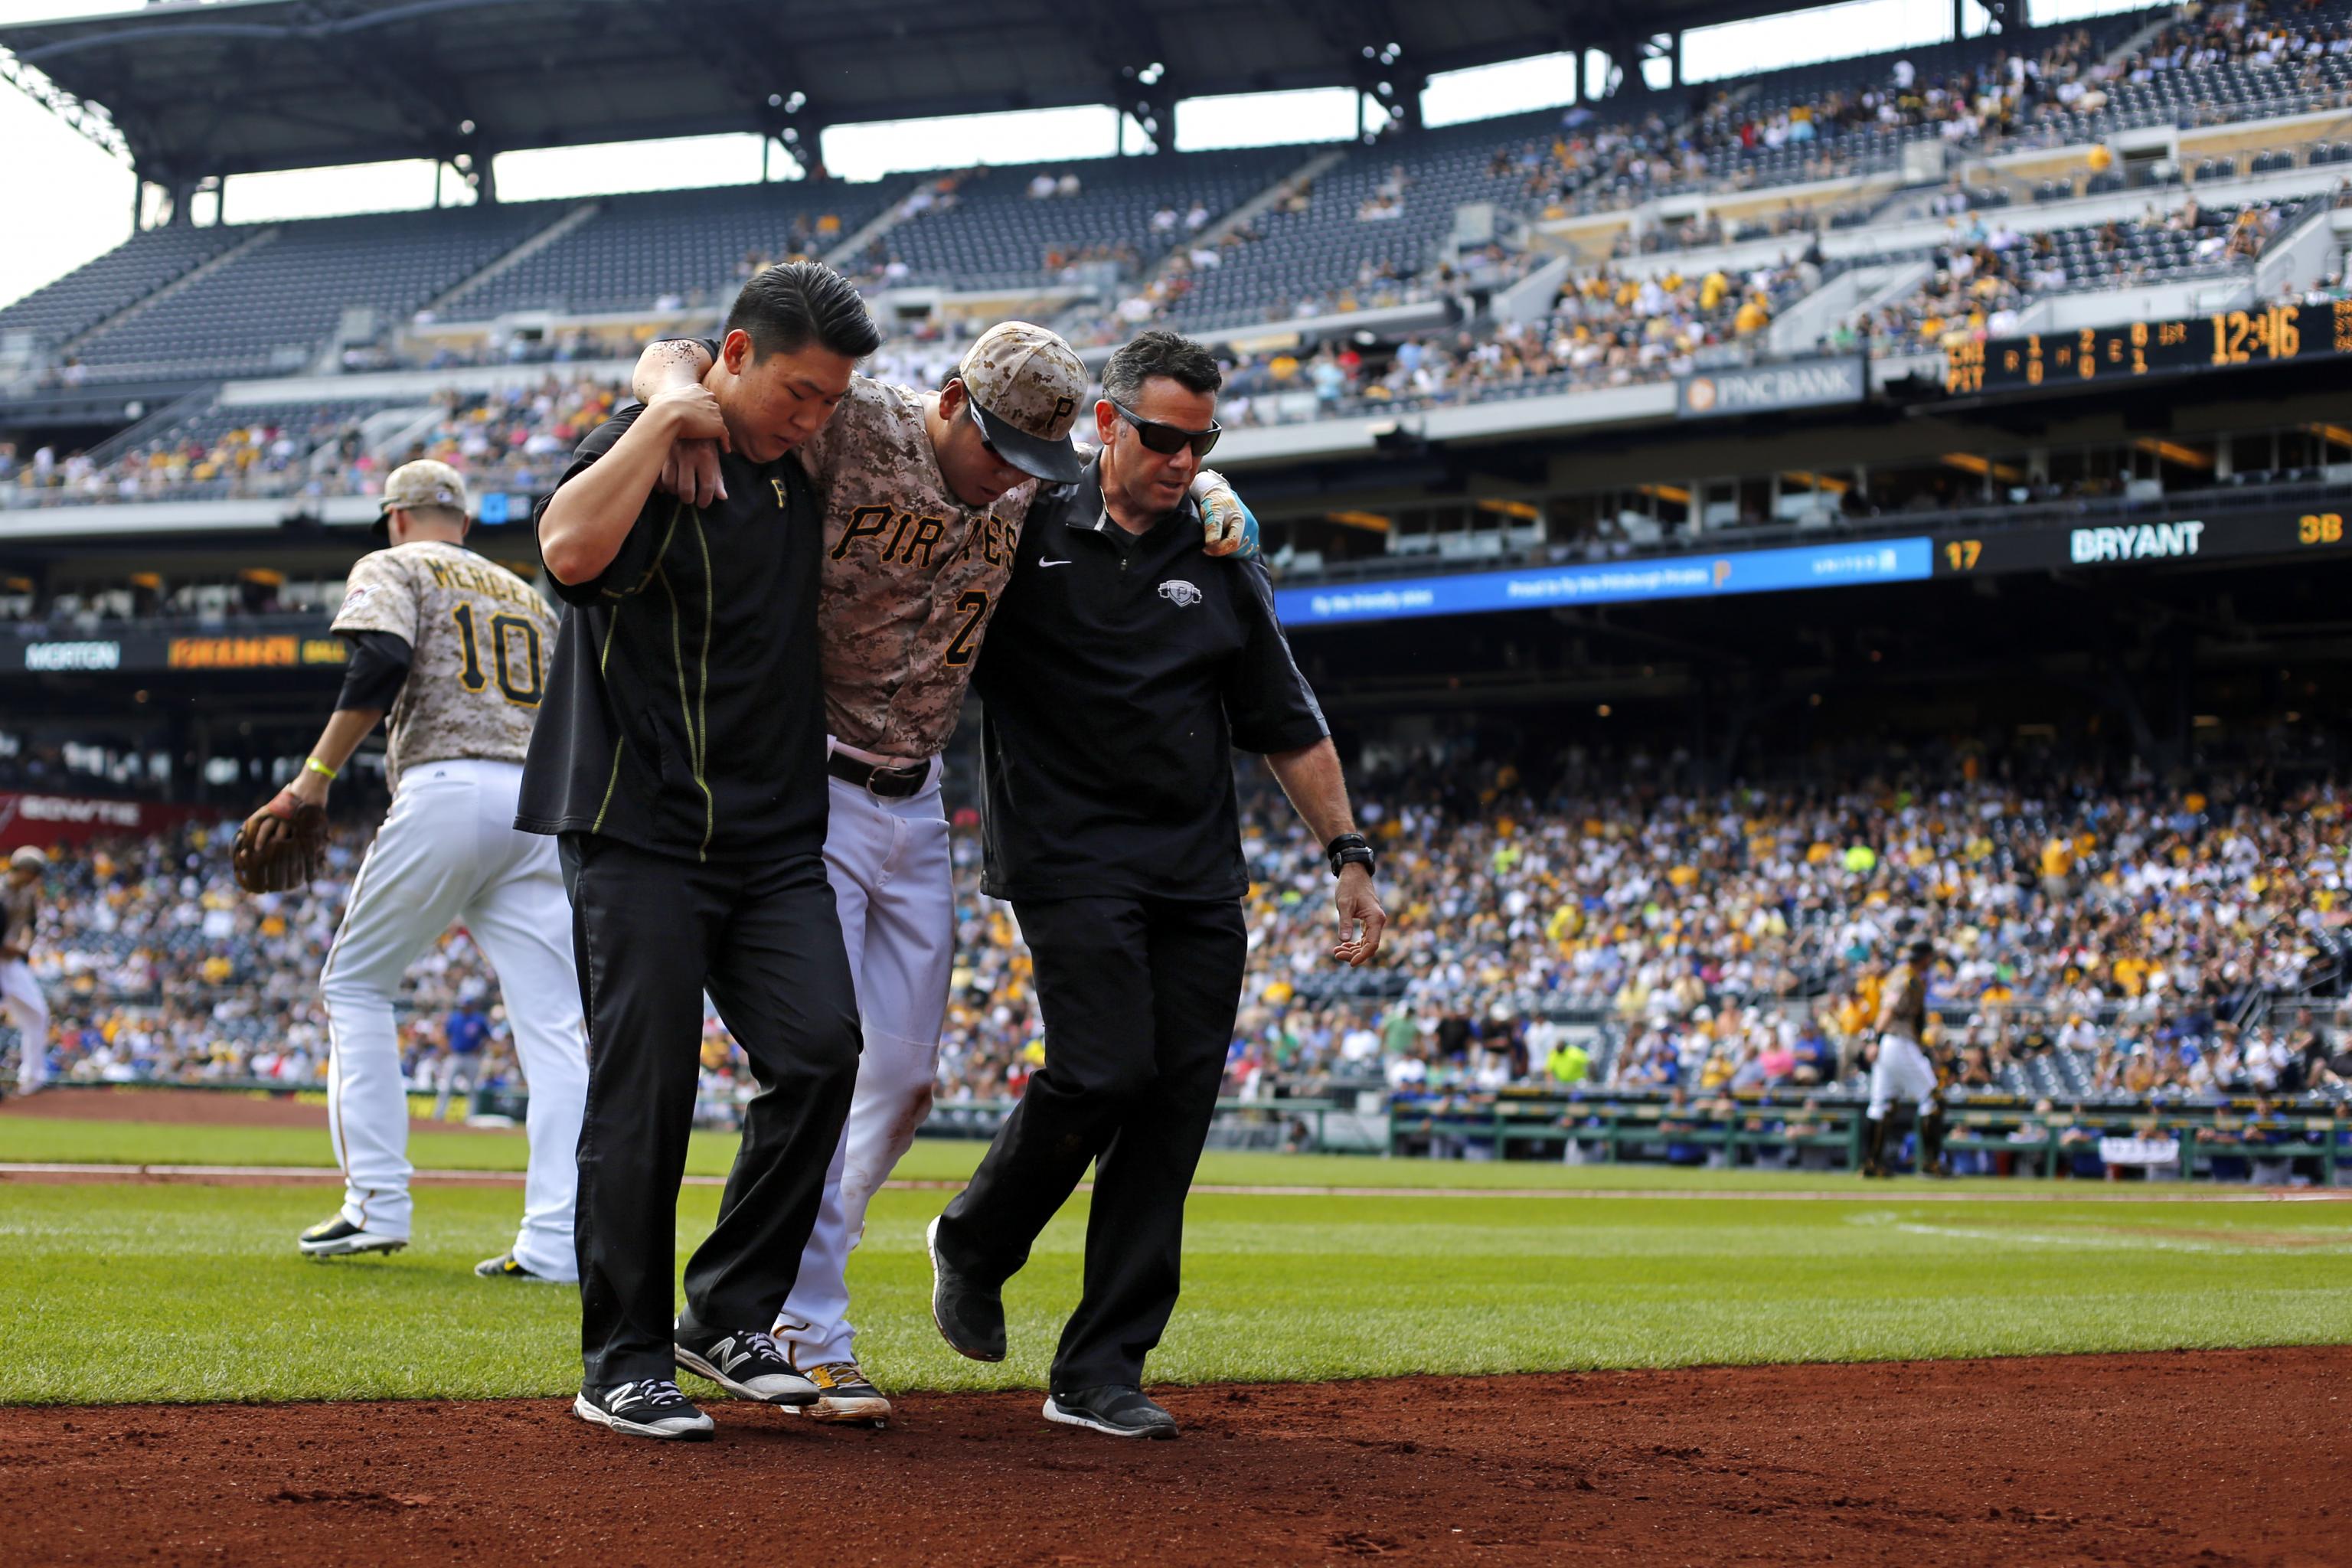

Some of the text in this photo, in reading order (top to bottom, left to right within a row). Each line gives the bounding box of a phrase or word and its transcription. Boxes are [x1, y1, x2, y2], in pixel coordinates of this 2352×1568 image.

[2210, 305, 2300, 367] 12:46
[1045, 395, 1073, 429] P
[2069, 520, 2205, 564] BRYANT
[2298, 513, 2344, 545] 3B
[1945, 539, 1982, 570] 17
[24, 640, 120, 670] MORTON
[451, 600, 545, 708] 10
